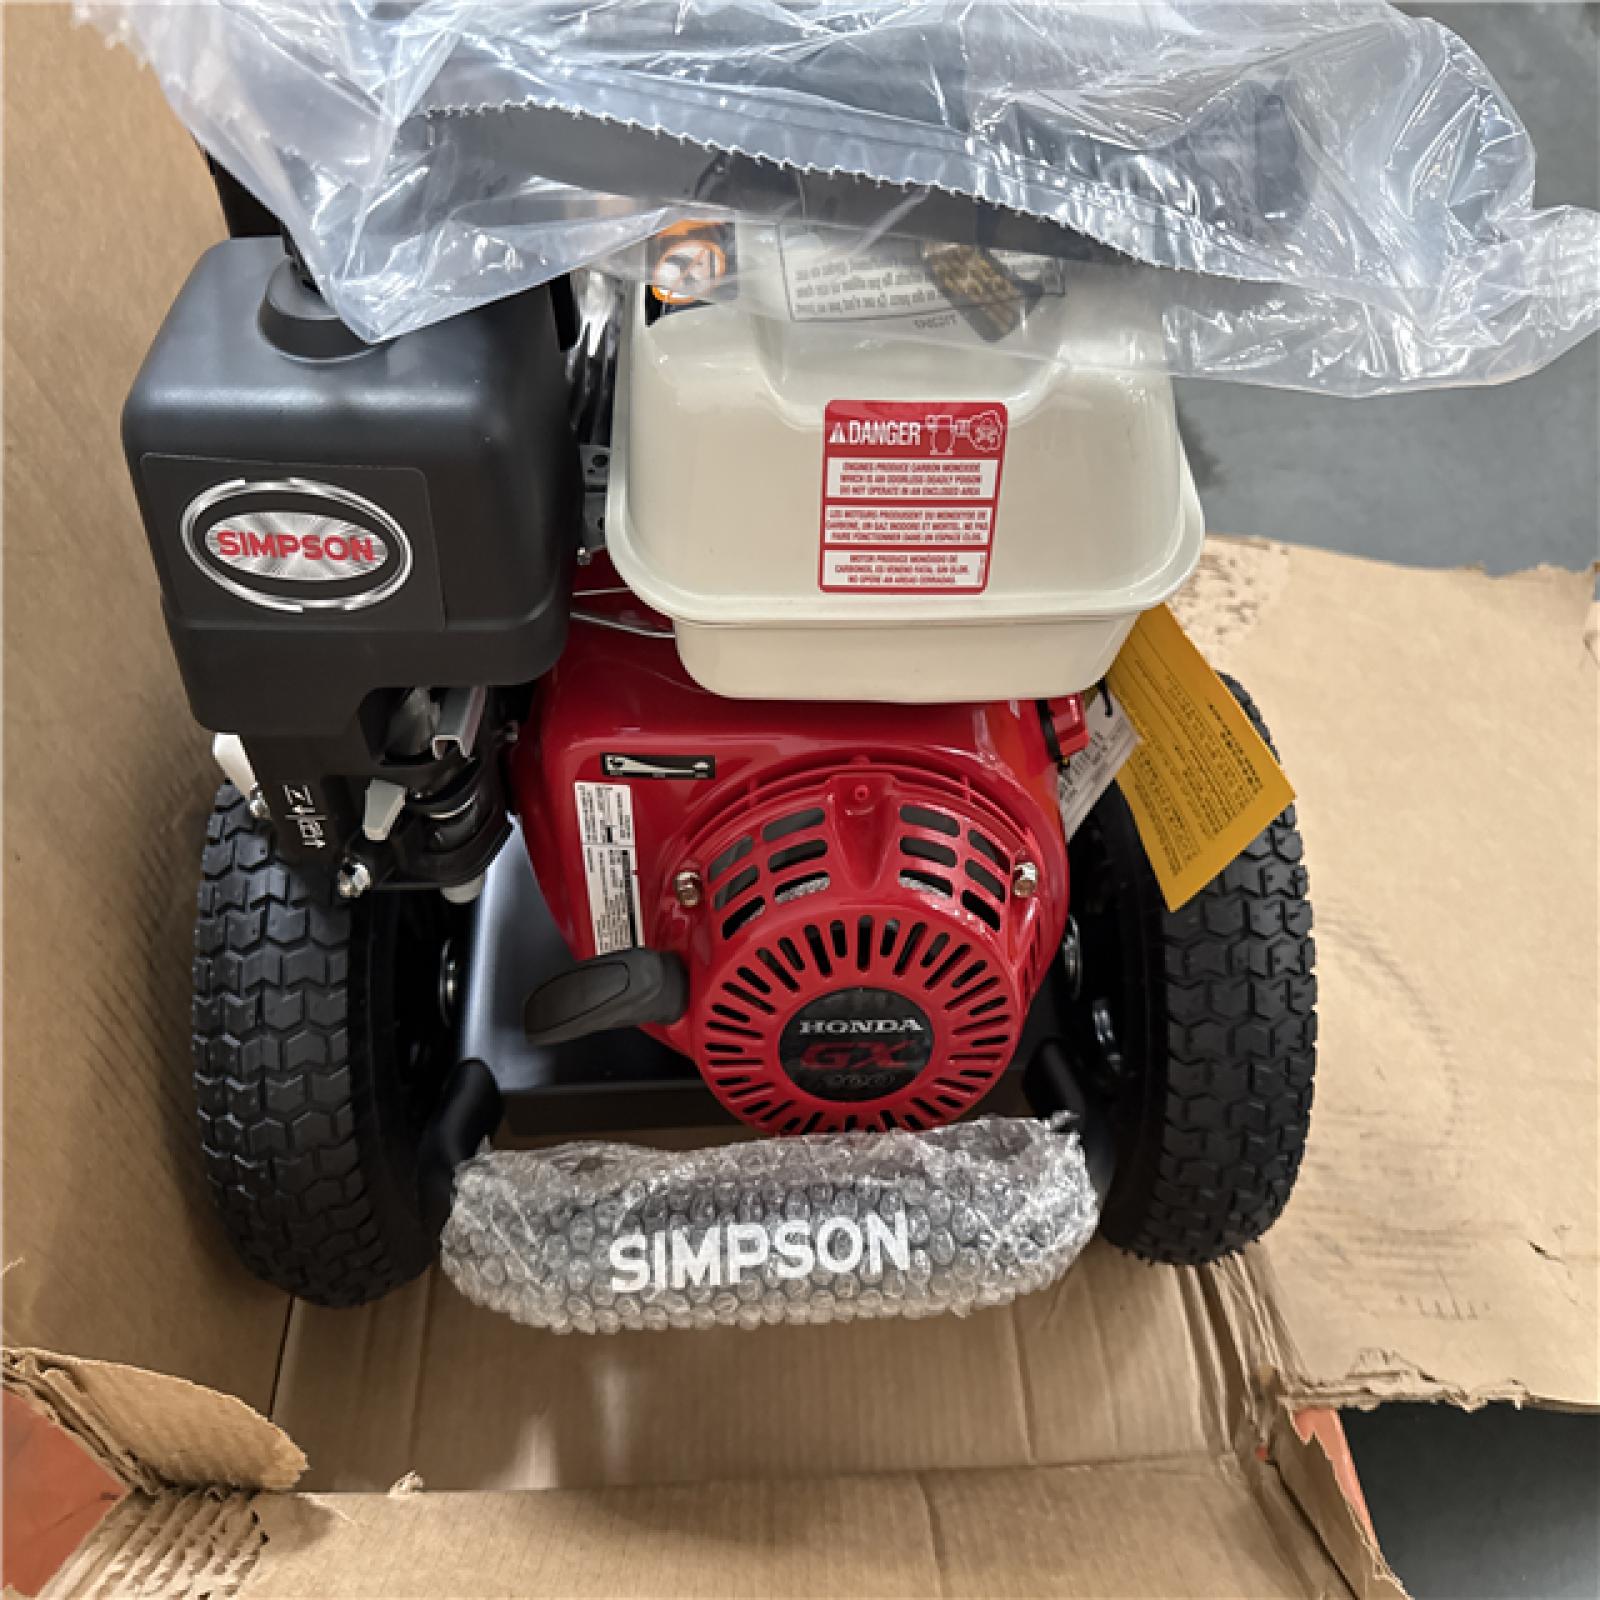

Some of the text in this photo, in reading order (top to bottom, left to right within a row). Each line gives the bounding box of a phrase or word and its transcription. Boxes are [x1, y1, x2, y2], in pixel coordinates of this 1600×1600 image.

[849, 420, 921, 445] DANGER
[216, 529, 377, 563] SIMPSON
[800, 1016, 924, 1034] HONDA
[800, 1040, 918, 1070] GX
[609, 1210, 911, 1293] SIMPSON
